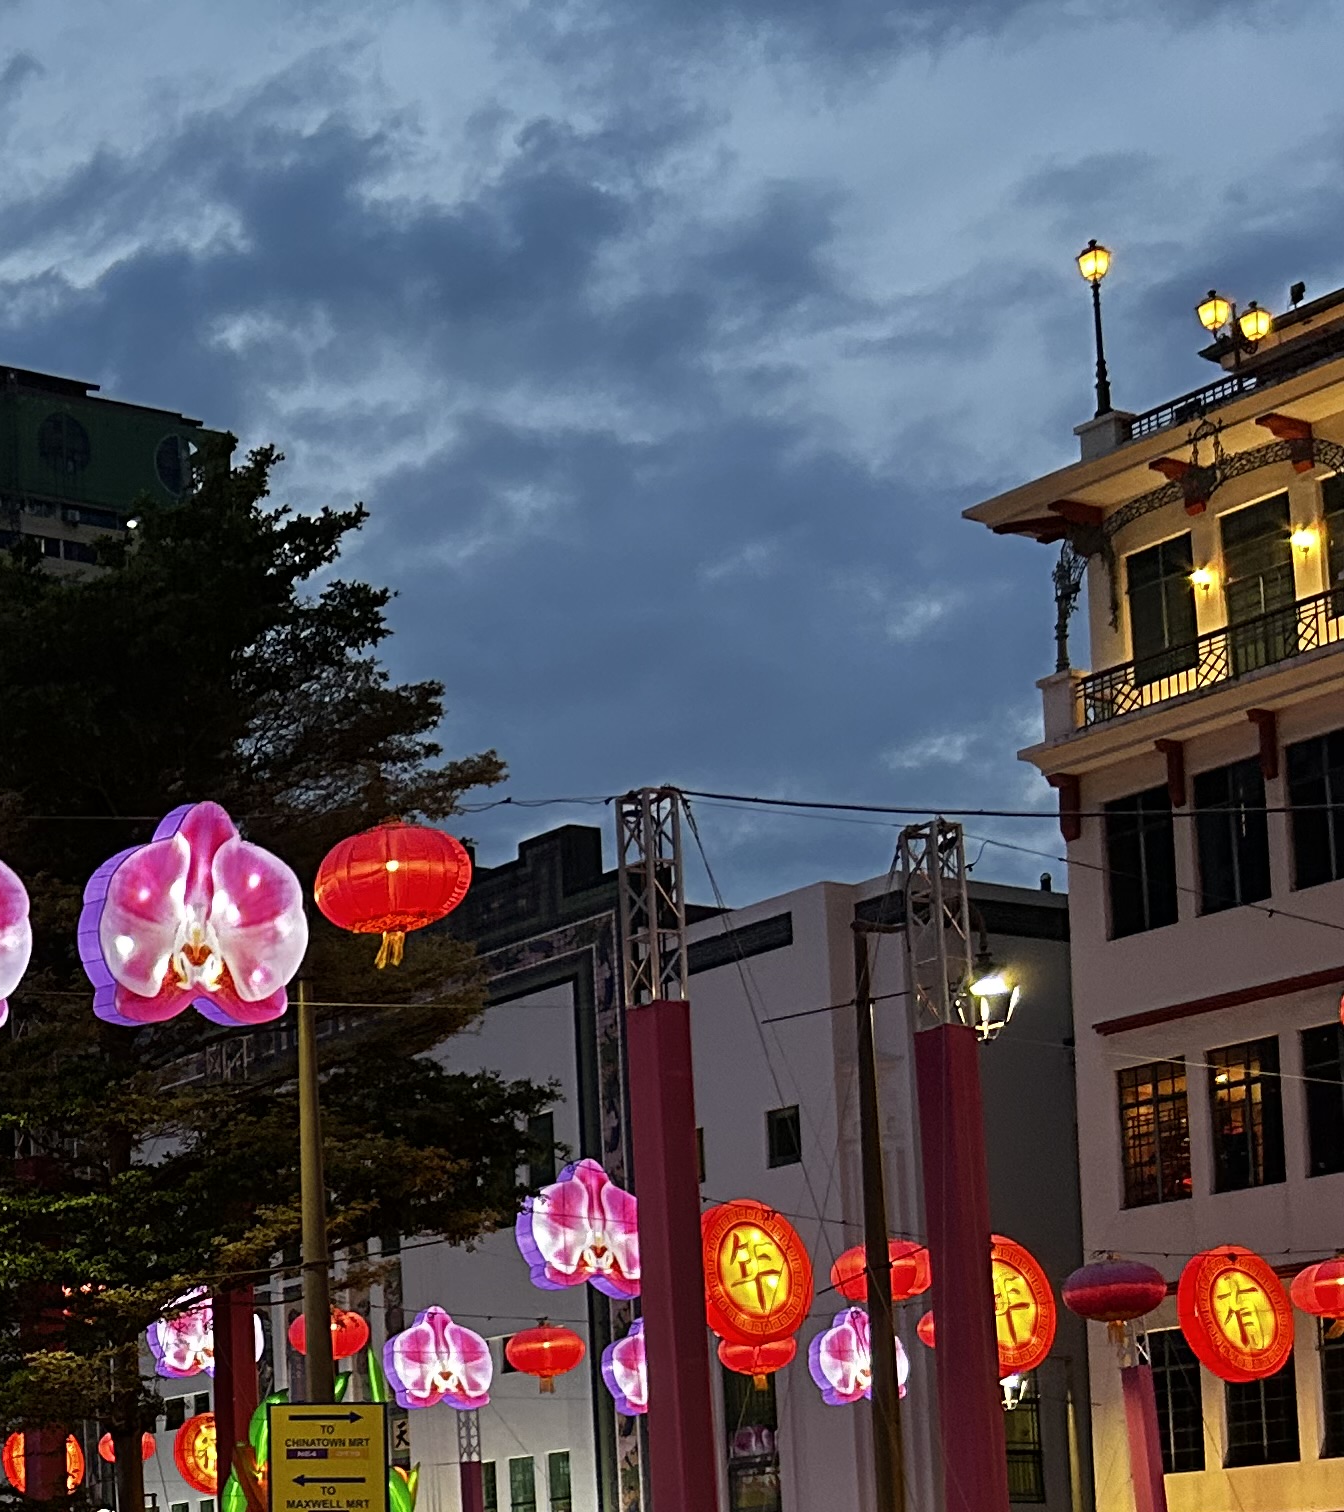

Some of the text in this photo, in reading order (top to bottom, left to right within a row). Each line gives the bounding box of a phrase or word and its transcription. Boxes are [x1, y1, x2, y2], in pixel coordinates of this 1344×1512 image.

[729, 1231, 782, 1314] 年
[320, 1425, 335, 1434] TO
[285, 1437, 370, 1448] CHINATOWN MRT
[320, 1486, 336, 1495] TO
[286, 1499, 370, 1509] MAXWELL MRT
